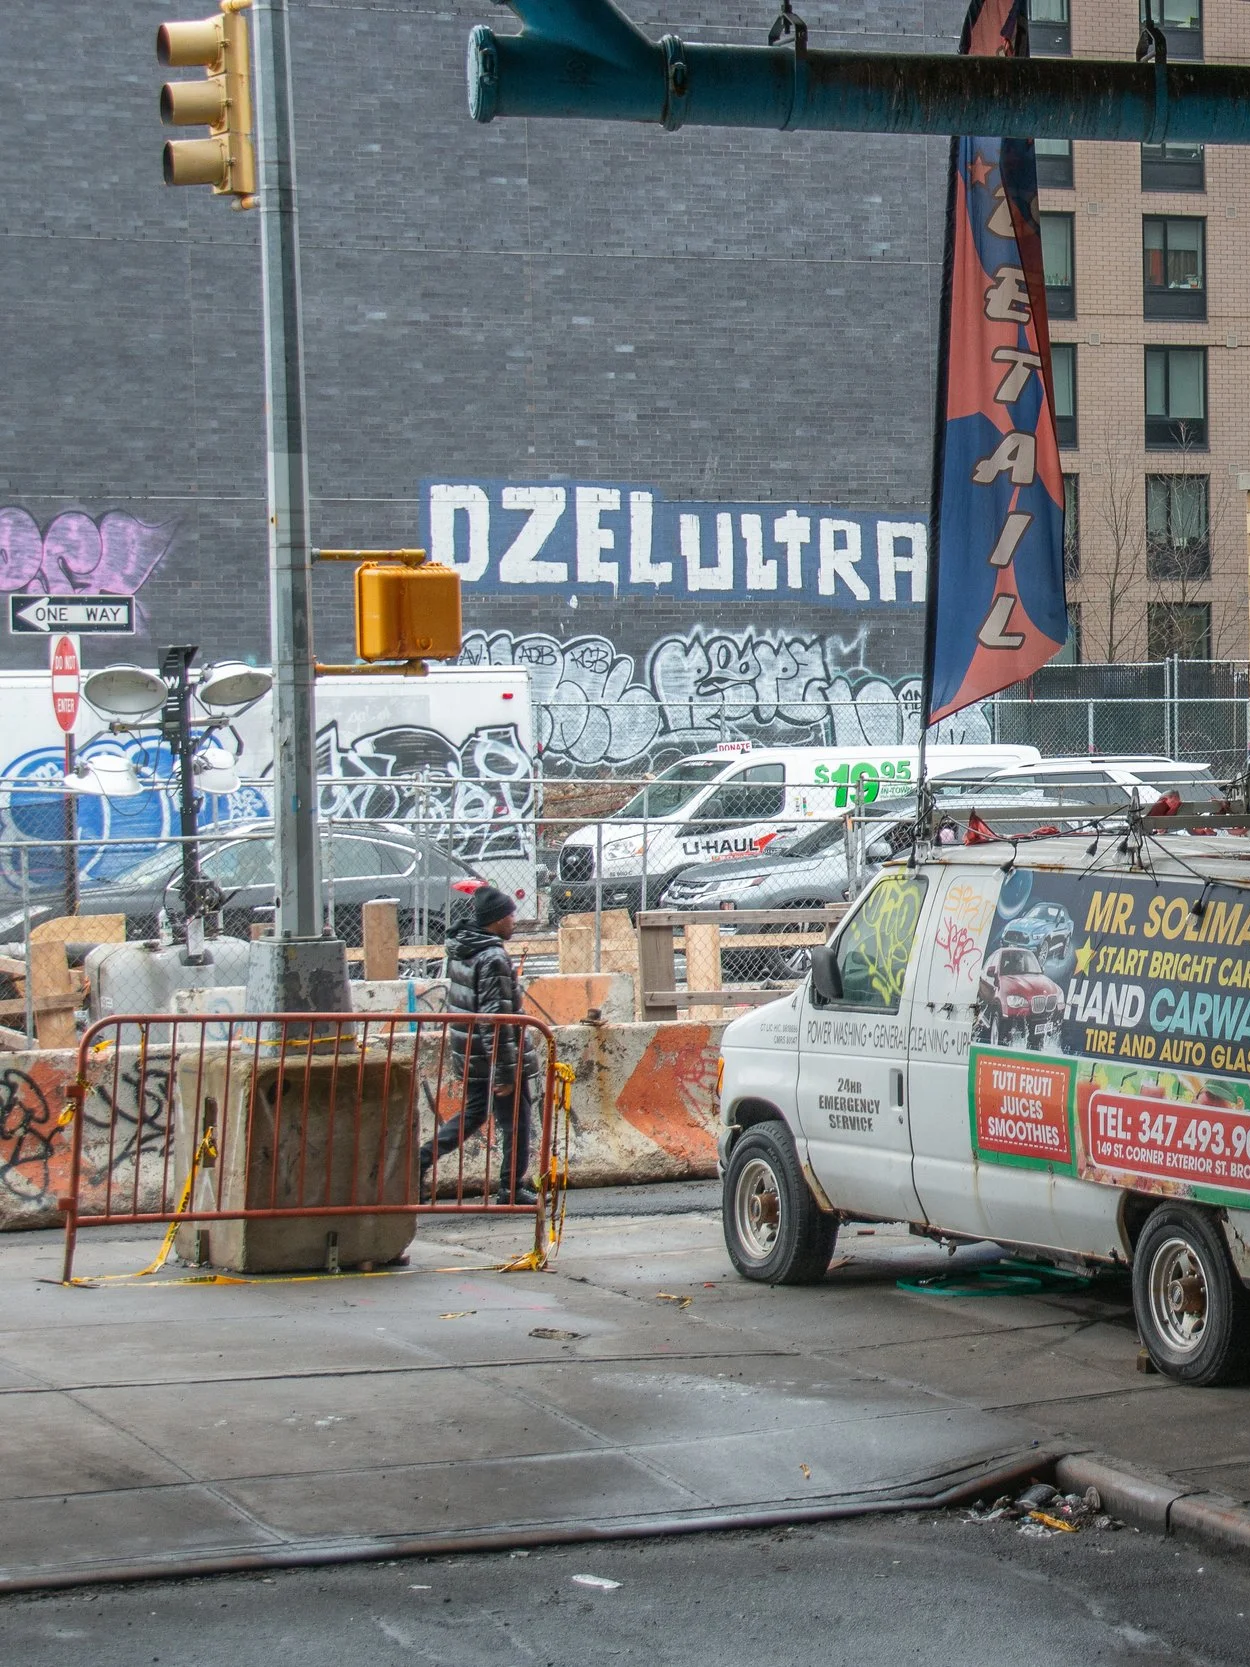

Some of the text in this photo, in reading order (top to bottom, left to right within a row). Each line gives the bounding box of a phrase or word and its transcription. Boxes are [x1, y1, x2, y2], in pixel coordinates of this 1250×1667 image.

[35, 607, 121, 621] ONE WAY
[55, 655, 76, 669] DO NOT
[57, 698, 75, 712] ENTER
[683, 838, 760, 855] U-HAUL
[1084, 891, 1135, 937] MR.
[1096, 946, 1149, 977] START
[1149, 951, 1217, 984] BRIGHT
[1064, 979, 1146, 1028] HAND
[807, 1021, 831, 1045] POWER
[833, 1022, 866, 1047] WASHING
[873, 1024, 908, 1051] GENERAL
[910, 1026, 949, 1054] CLEANING
[1085, 1029, 1116, 1055] TIRE
[1119, 1032, 1156, 1059] AND
[1159, 1037, 1206, 1066] AUTO
[992, 1069, 1052, 1097] TUTI FRUTI
[819, 1096, 880, 1115] EMERGENCY
[1000, 1094, 1043, 1120] JUICES
[829, 1114, 874, 1132] SERVICE
[987, 1119, 1060, 1146] SMOOTHIES
[1096, 1104, 1132, 1139] TEL:
[1096, 1140, 1112, 1156] 149
[1113, 1142, 1125, 1158] ST.
[1126, 1145, 1164, 1166] CORNER
[1166, 1150, 1213, 1174] EXTERIOR
[1215, 1157, 1229, 1175] ST.
